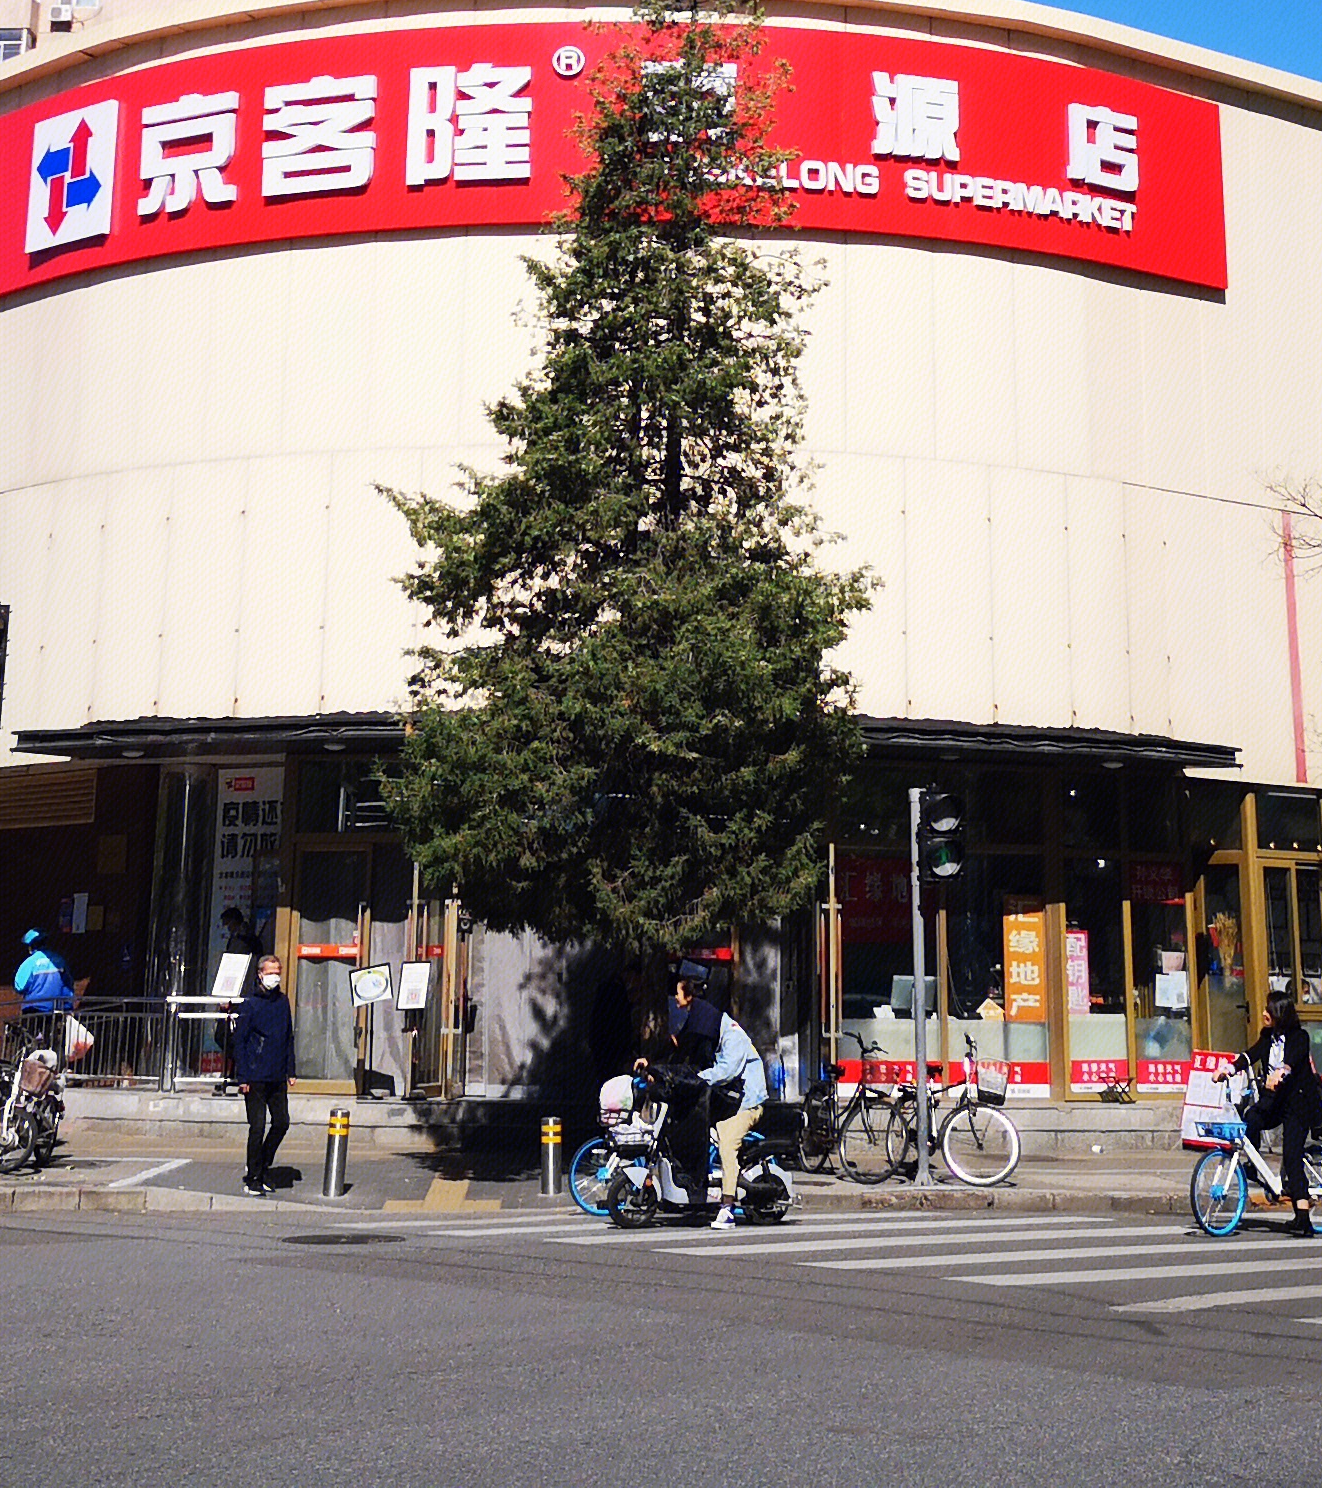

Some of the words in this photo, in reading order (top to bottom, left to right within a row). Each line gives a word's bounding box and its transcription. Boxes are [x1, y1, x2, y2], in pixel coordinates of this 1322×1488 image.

[137, 62, 532, 216] 京客隆
[904, 169, 1137, 231] SUPERMARKET
[222, 800, 284, 827] 疫情还
[1066, 933, 1086, 1010] 配钥匙
